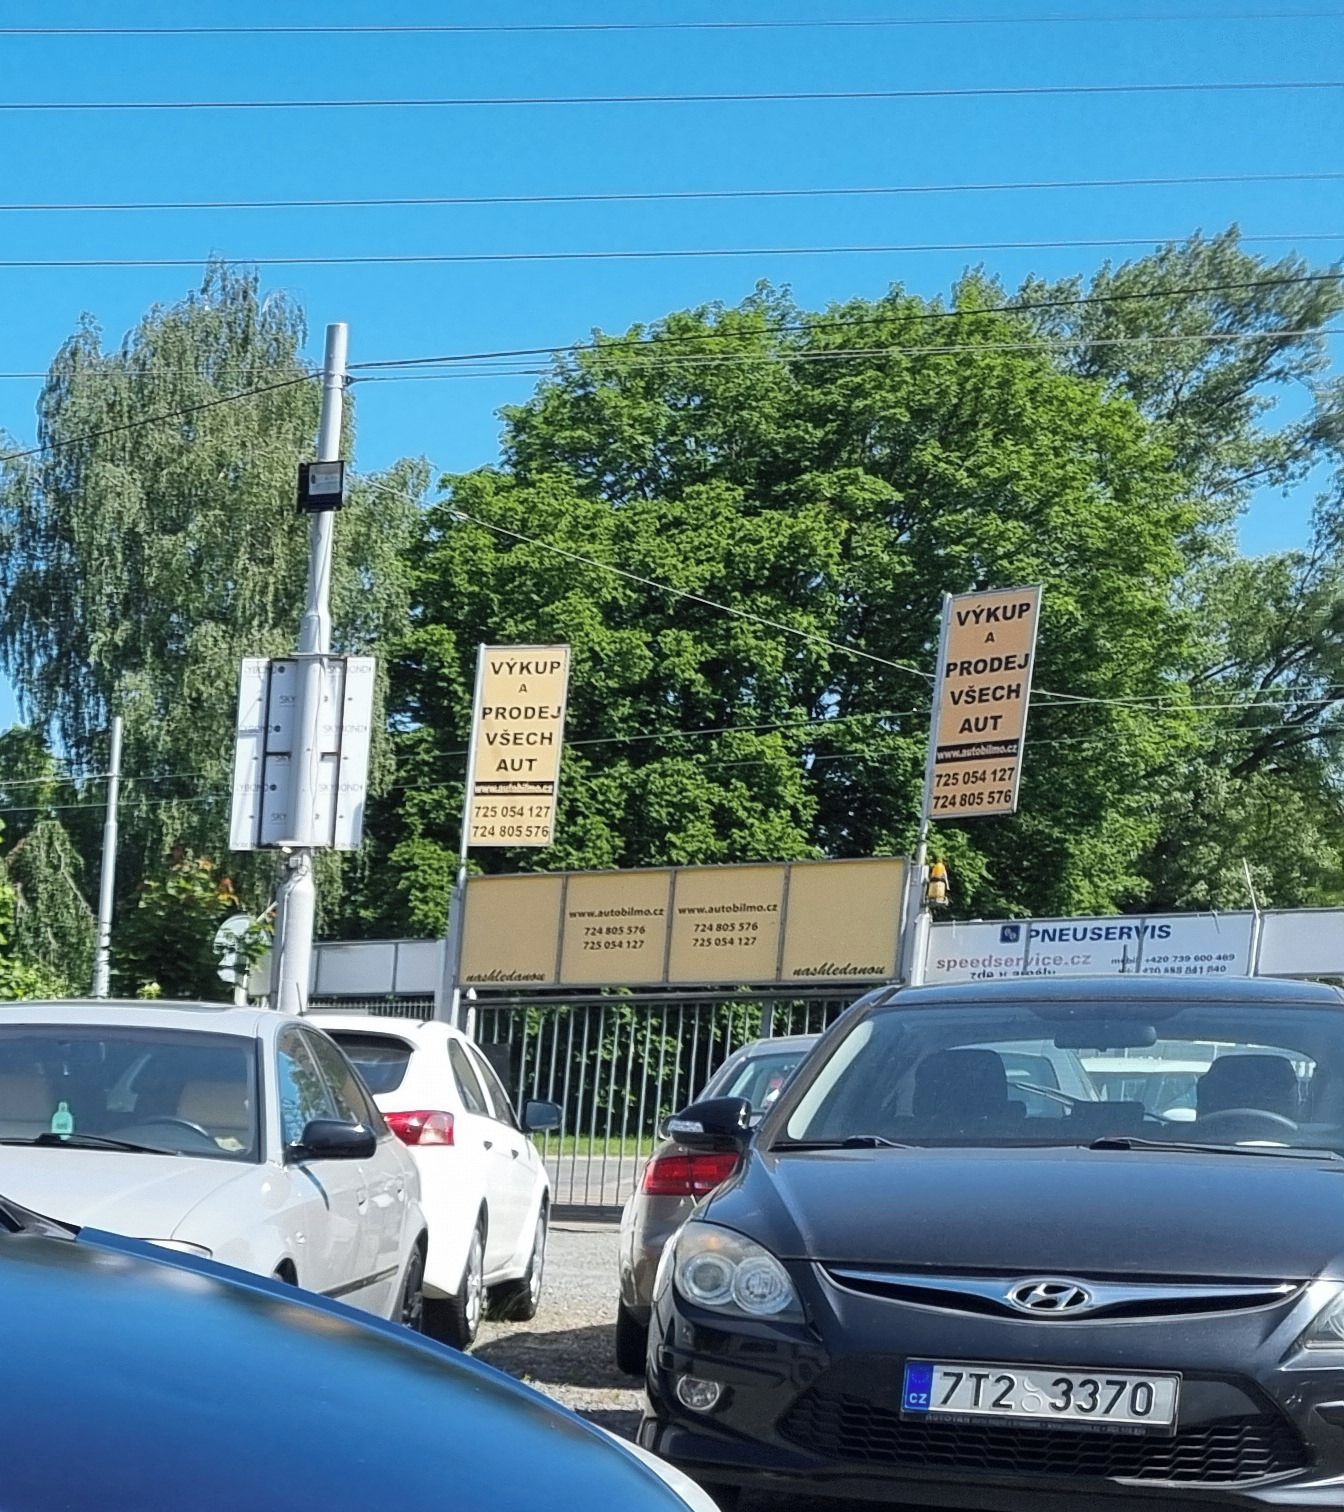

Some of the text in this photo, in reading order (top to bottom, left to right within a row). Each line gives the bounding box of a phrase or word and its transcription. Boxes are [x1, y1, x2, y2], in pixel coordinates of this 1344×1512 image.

[956, 603, 1031, 627] VÝKUP
[984, 631, 996, 644] A
[490, 657, 561, 675] VÝKUP
[945, 652, 1030, 678] PRODEJ
[518, 683, 528, 693] A
[950, 683, 1022, 706] VŠECH
[481, 706, 562, 720] PRODEJ
[958, 714, 1003, 734] AUT
[485, 729, 553, 746] VŠECH
[937, 744, 1018, 760] www.autobilmo.cz
[495, 758, 538, 772] AUT
[935, 767, 1015, 788] 725 054 127
[932, 789, 1012, 809] 724 805 576
[474, 806, 551, 818] 725 054 127
[472, 825, 549, 838] 724 805 576
[569, 907, 665, 919] www.autobilmo.cz
[678, 903, 778, 915] www.autobilmo.cz
[584, 925, 646, 936] 724 805 576
[693, 921, 759, 932] 724 805 576
[1029, 924, 1172, 943] PNEUSERVIS
[583, 939, 645, 950] 725 054 127
[692, 936, 757, 947] 725 054 127
[466, 969, 546, 983] nashledanou
[792, 962, 886, 977] nashledanou
[909, 1393, 927, 1405] CZ
[940, 1370, 1155, 1418] 7T2 3370
